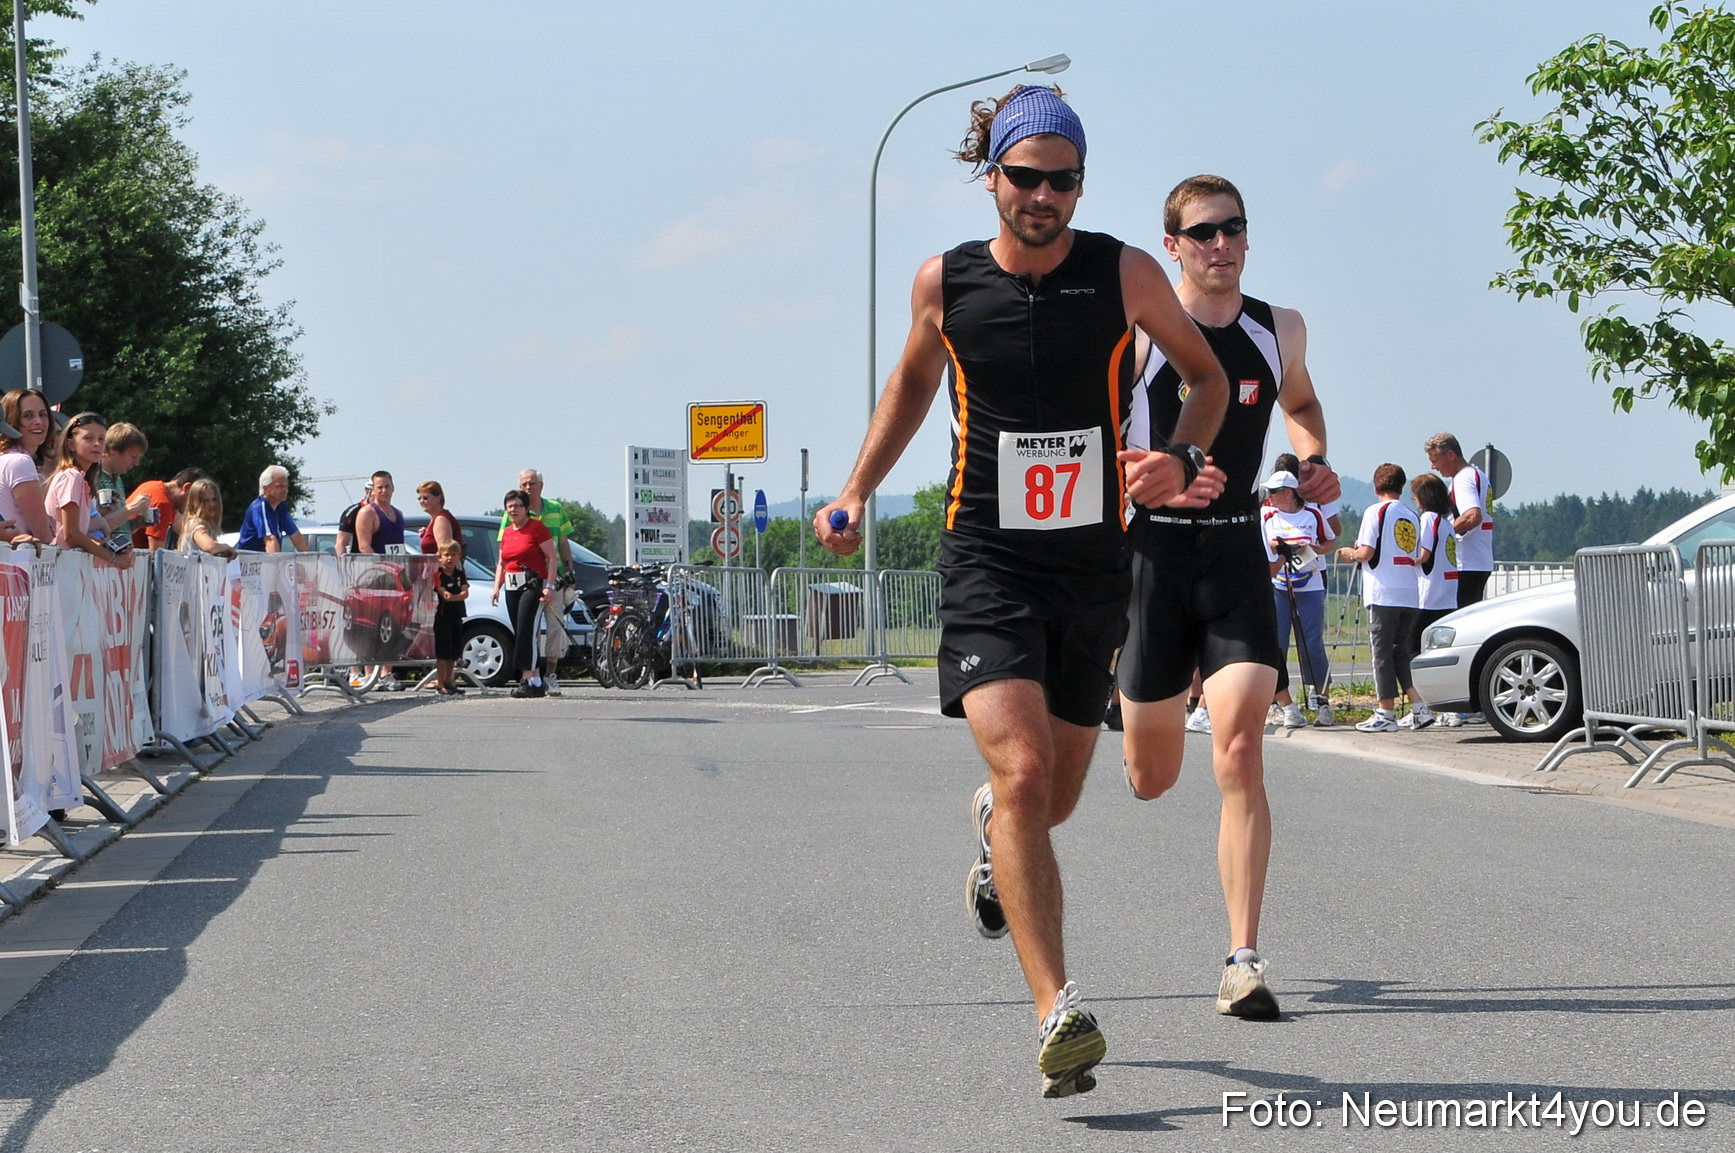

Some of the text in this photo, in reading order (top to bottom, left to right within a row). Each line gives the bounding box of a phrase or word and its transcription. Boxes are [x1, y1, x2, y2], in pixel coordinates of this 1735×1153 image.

[697, 411, 757, 429] Sengenthal
[722, 430, 749, 439] Anger
[1016, 436, 1066, 449] MEYER
[1016, 448, 1067, 458] WERBUNG
[1025, 462, 1081, 521] 87
[720, 500, 736, 515] 60
[507, 573, 518, 588] 14
